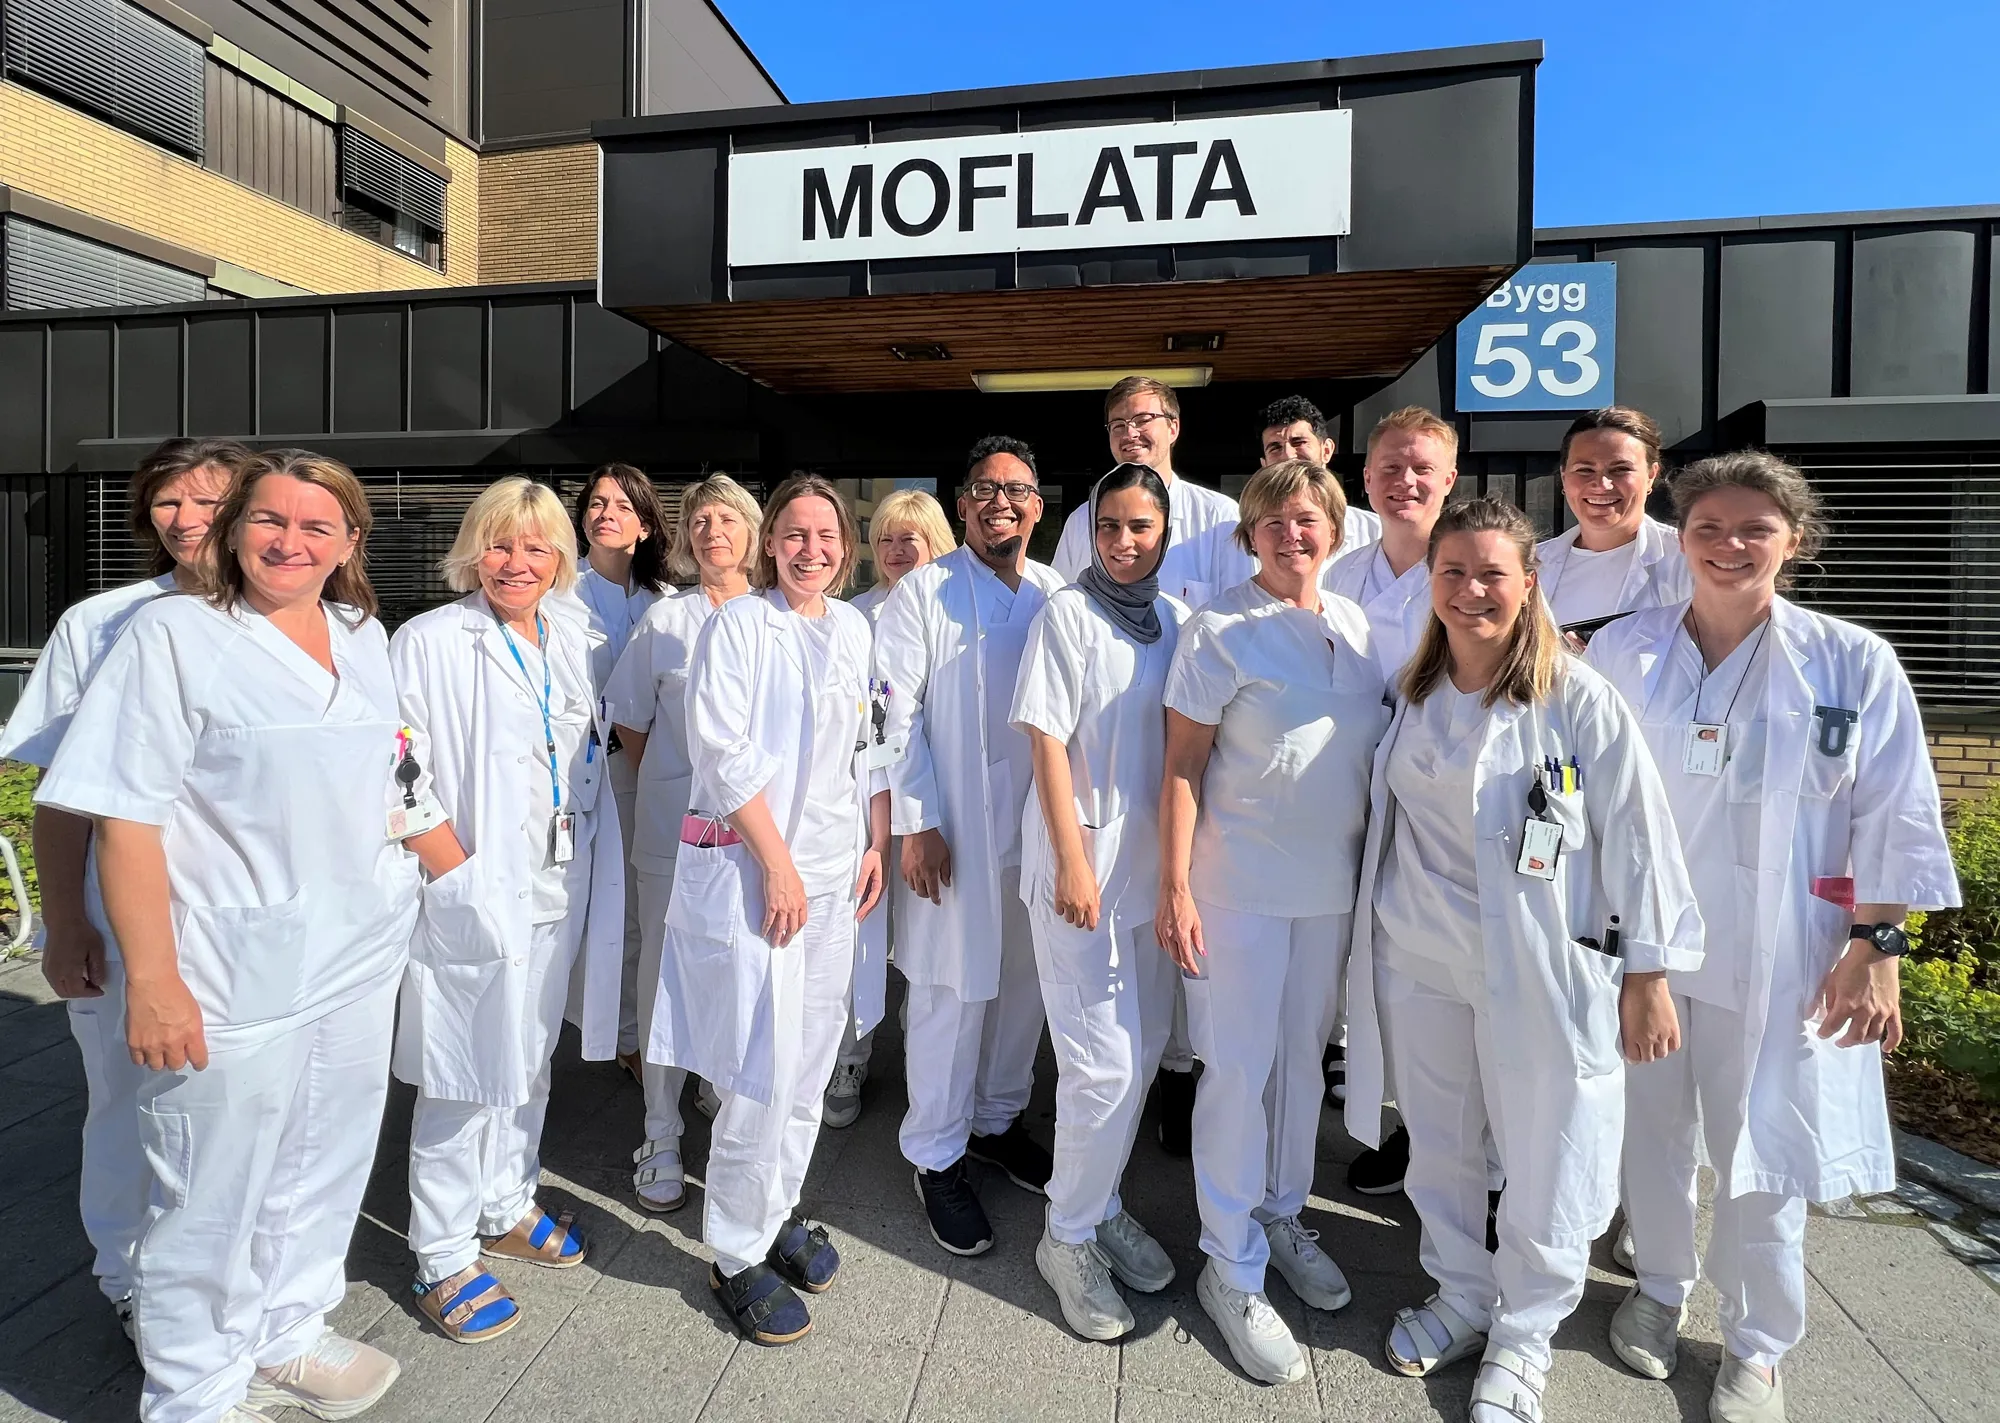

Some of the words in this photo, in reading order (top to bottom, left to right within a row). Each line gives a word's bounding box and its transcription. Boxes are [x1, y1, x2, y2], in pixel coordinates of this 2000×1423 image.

[802, 138, 1257, 241] MOFLATA
[1486, 278, 1587, 313] Bygg
[1470, 320, 1600, 398] 53
